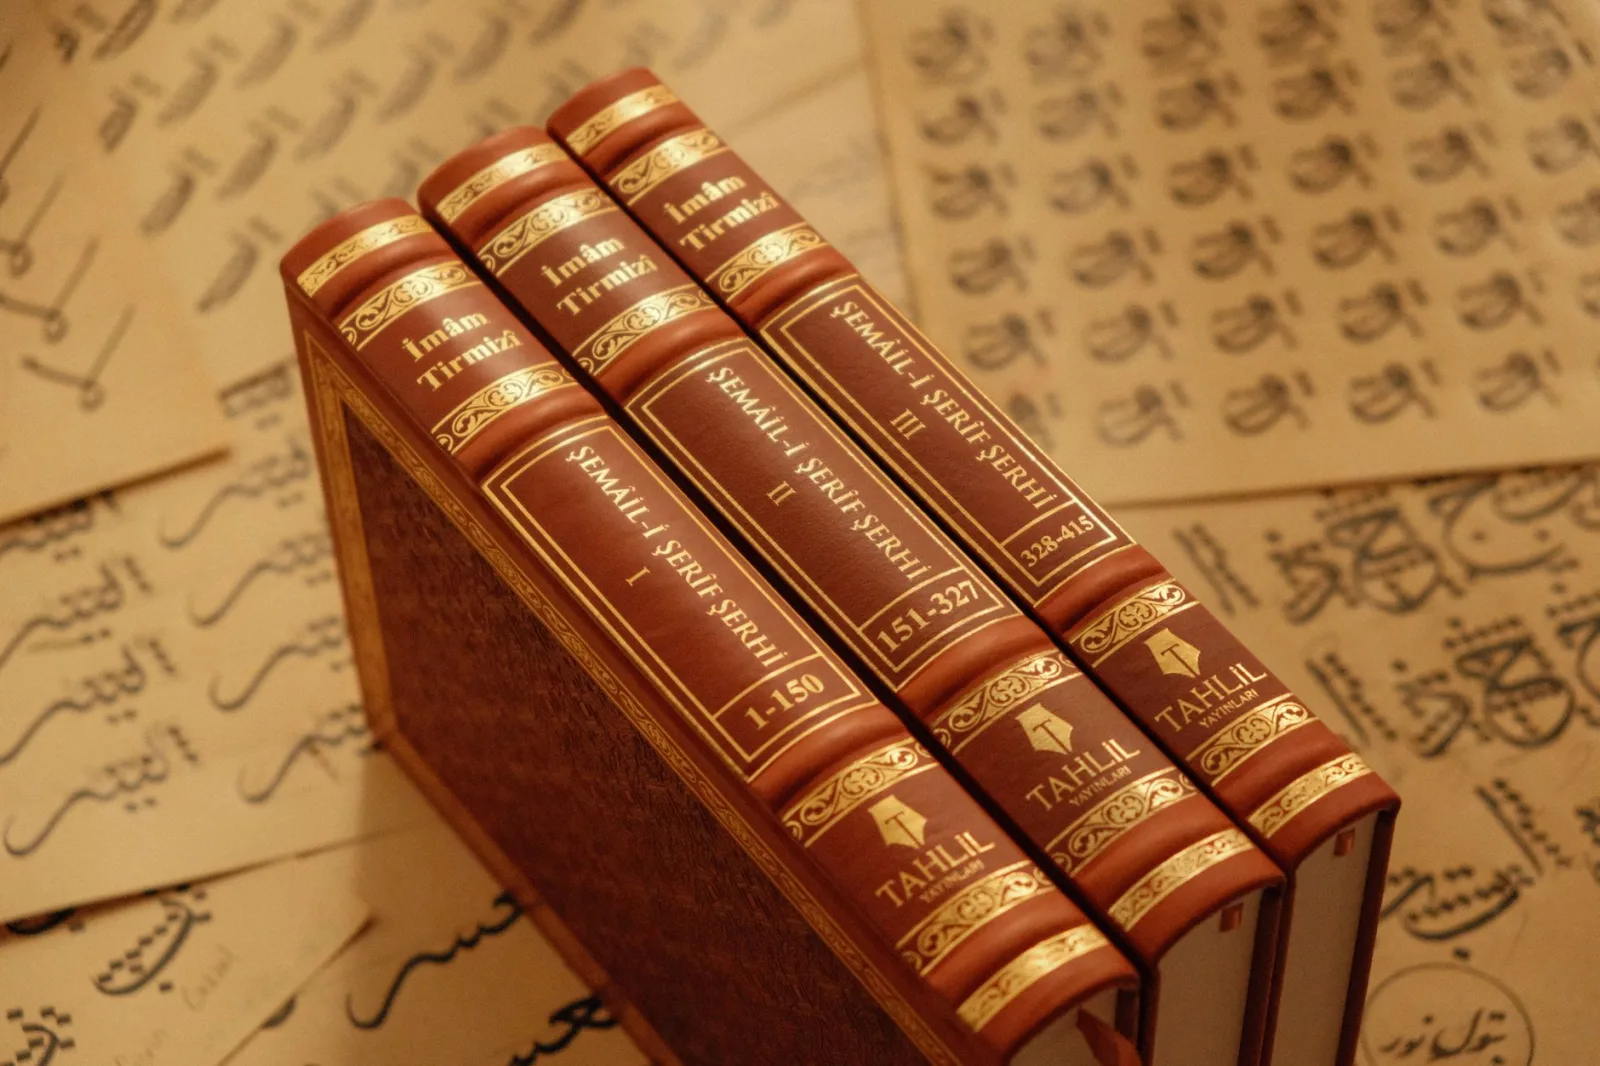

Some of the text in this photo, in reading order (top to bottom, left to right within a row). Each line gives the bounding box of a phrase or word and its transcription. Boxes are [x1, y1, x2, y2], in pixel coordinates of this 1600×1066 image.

[664, 176, 747, 224] İmâm
[679, 190, 779, 251] Tirmizî
[540, 238, 625, 288] İmâm
[556, 254, 658, 316] Tirmizî
[402, 313, 490, 362] İmâm
[416, 329, 523, 392] Tirmizî
[890, 408, 926, 440] III
[766, 480, 796, 507] II
[975, 444, 1058, 509] ŞERHİ
[850, 514, 932, 581] ŞERHİ
[1020, 514, 1095, 568] 328-415
[625, 566, 650, 587] I
[706, 599, 788, 667] ŞERHİ
[877, 579, 979, 652] 151-327
[744, 673, 825, 730] 1-150
[1154, 663, 1268, 732] TAHLİL
[1199, 688, 1259, 728] YAYINLARI
[1025, 738, 1141, 811] TAHLİL
